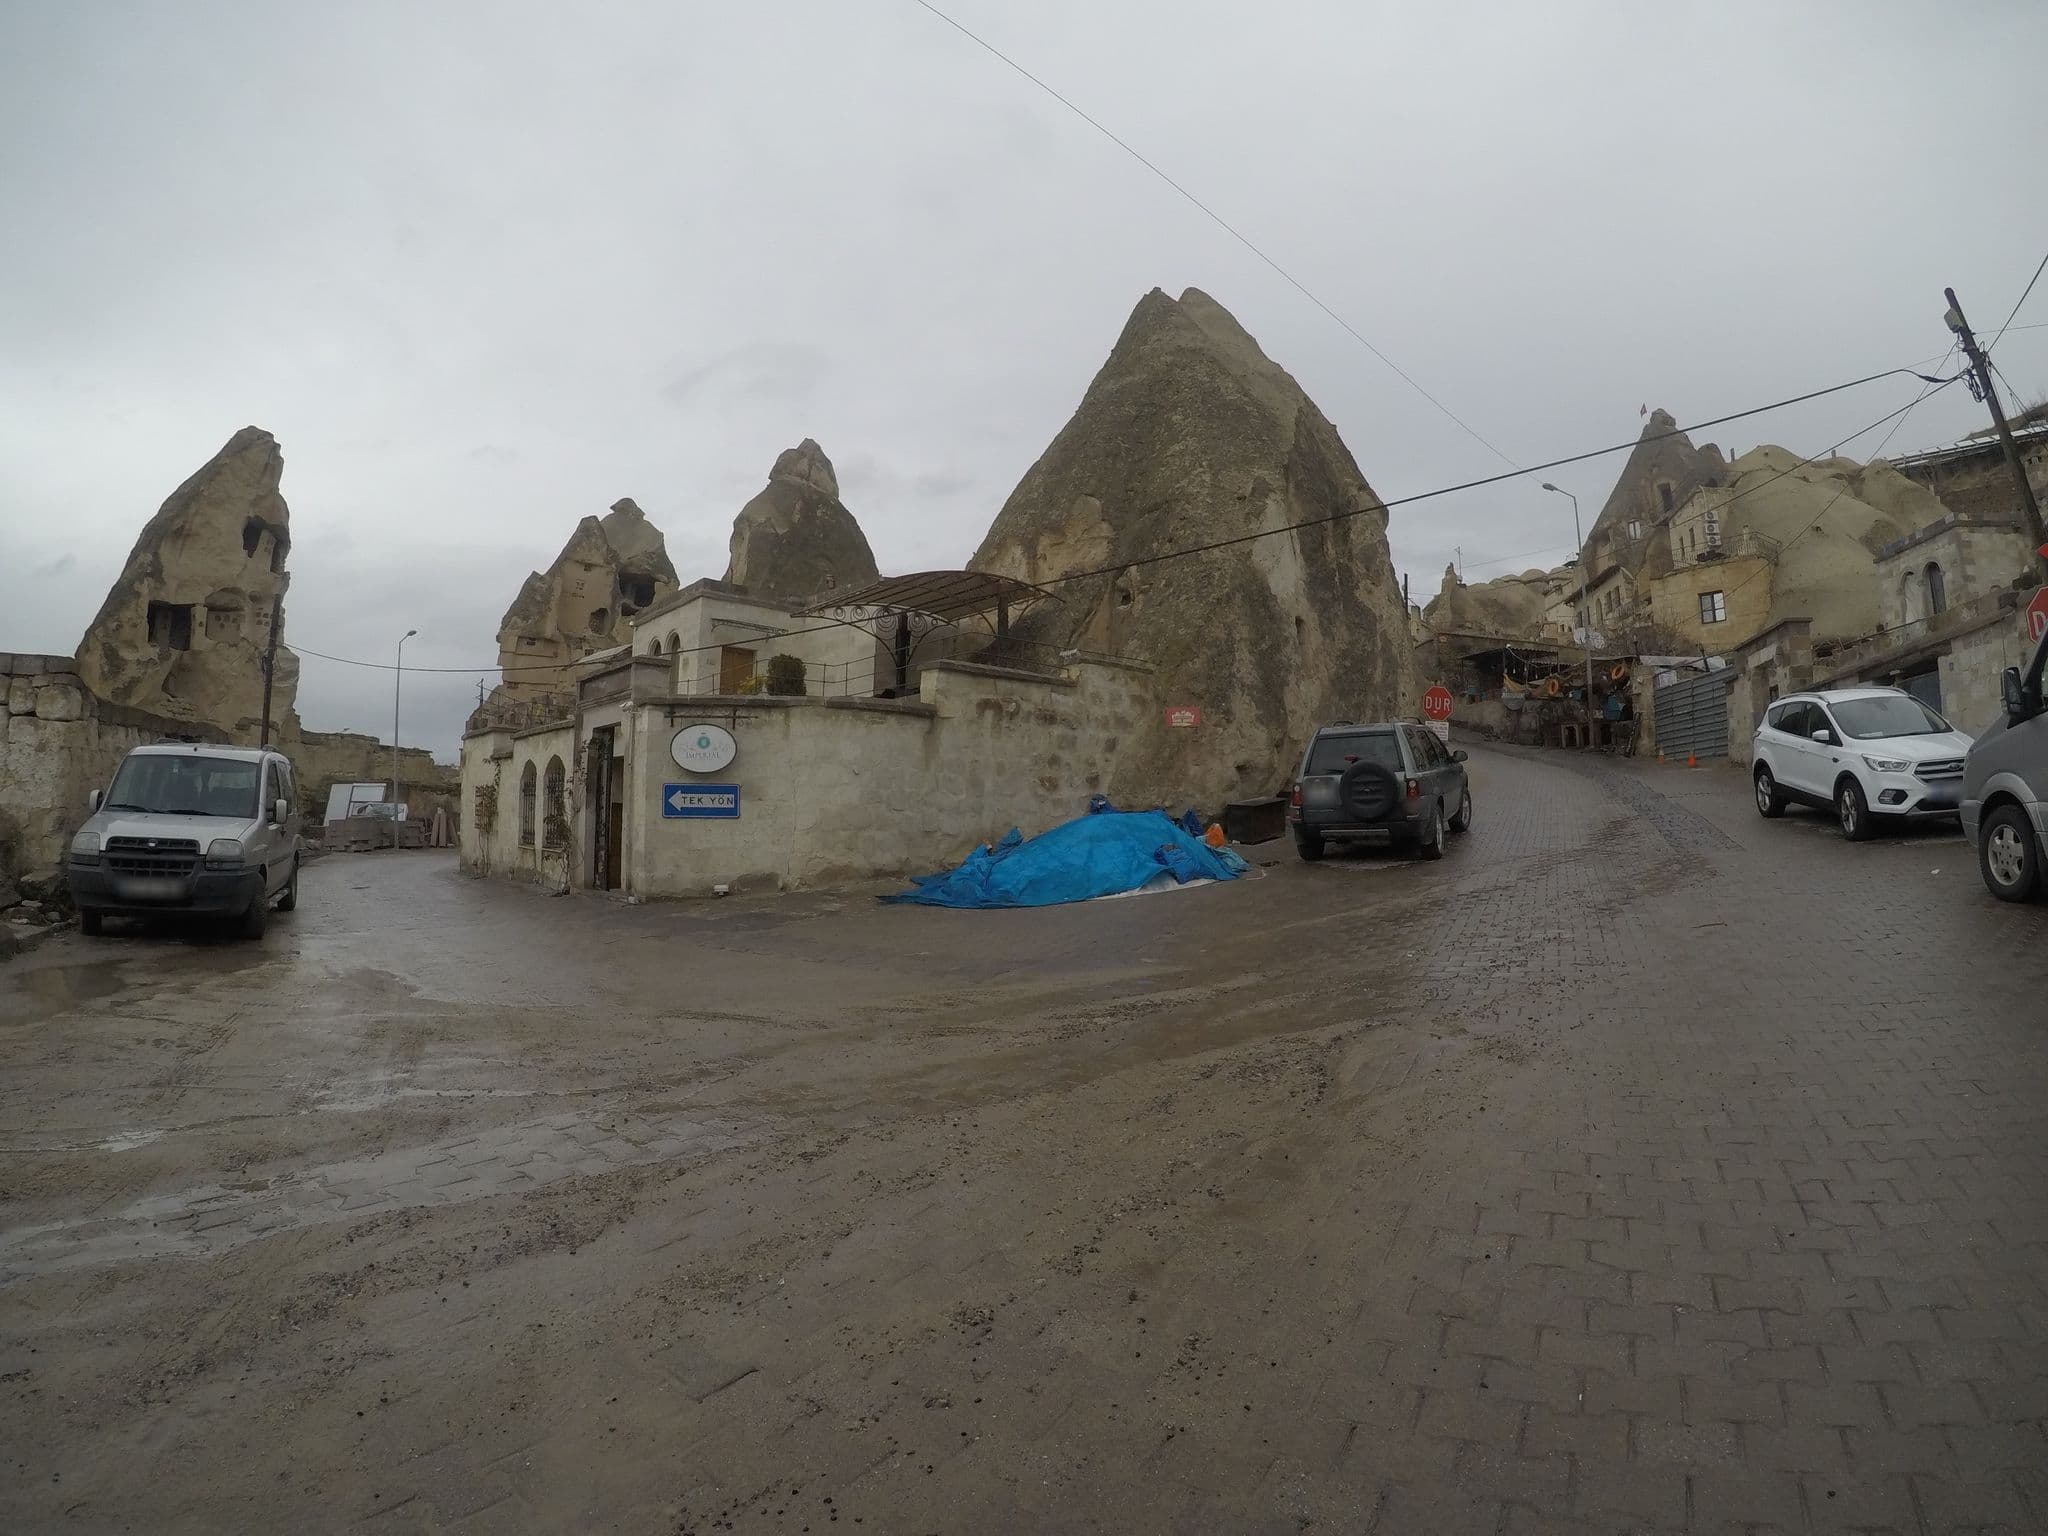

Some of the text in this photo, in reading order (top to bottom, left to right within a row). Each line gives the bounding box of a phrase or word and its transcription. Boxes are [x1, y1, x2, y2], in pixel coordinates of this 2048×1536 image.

[1425, 696, 1451, 712] DUR
[681, 794, 734, 805] TEK YÖN
